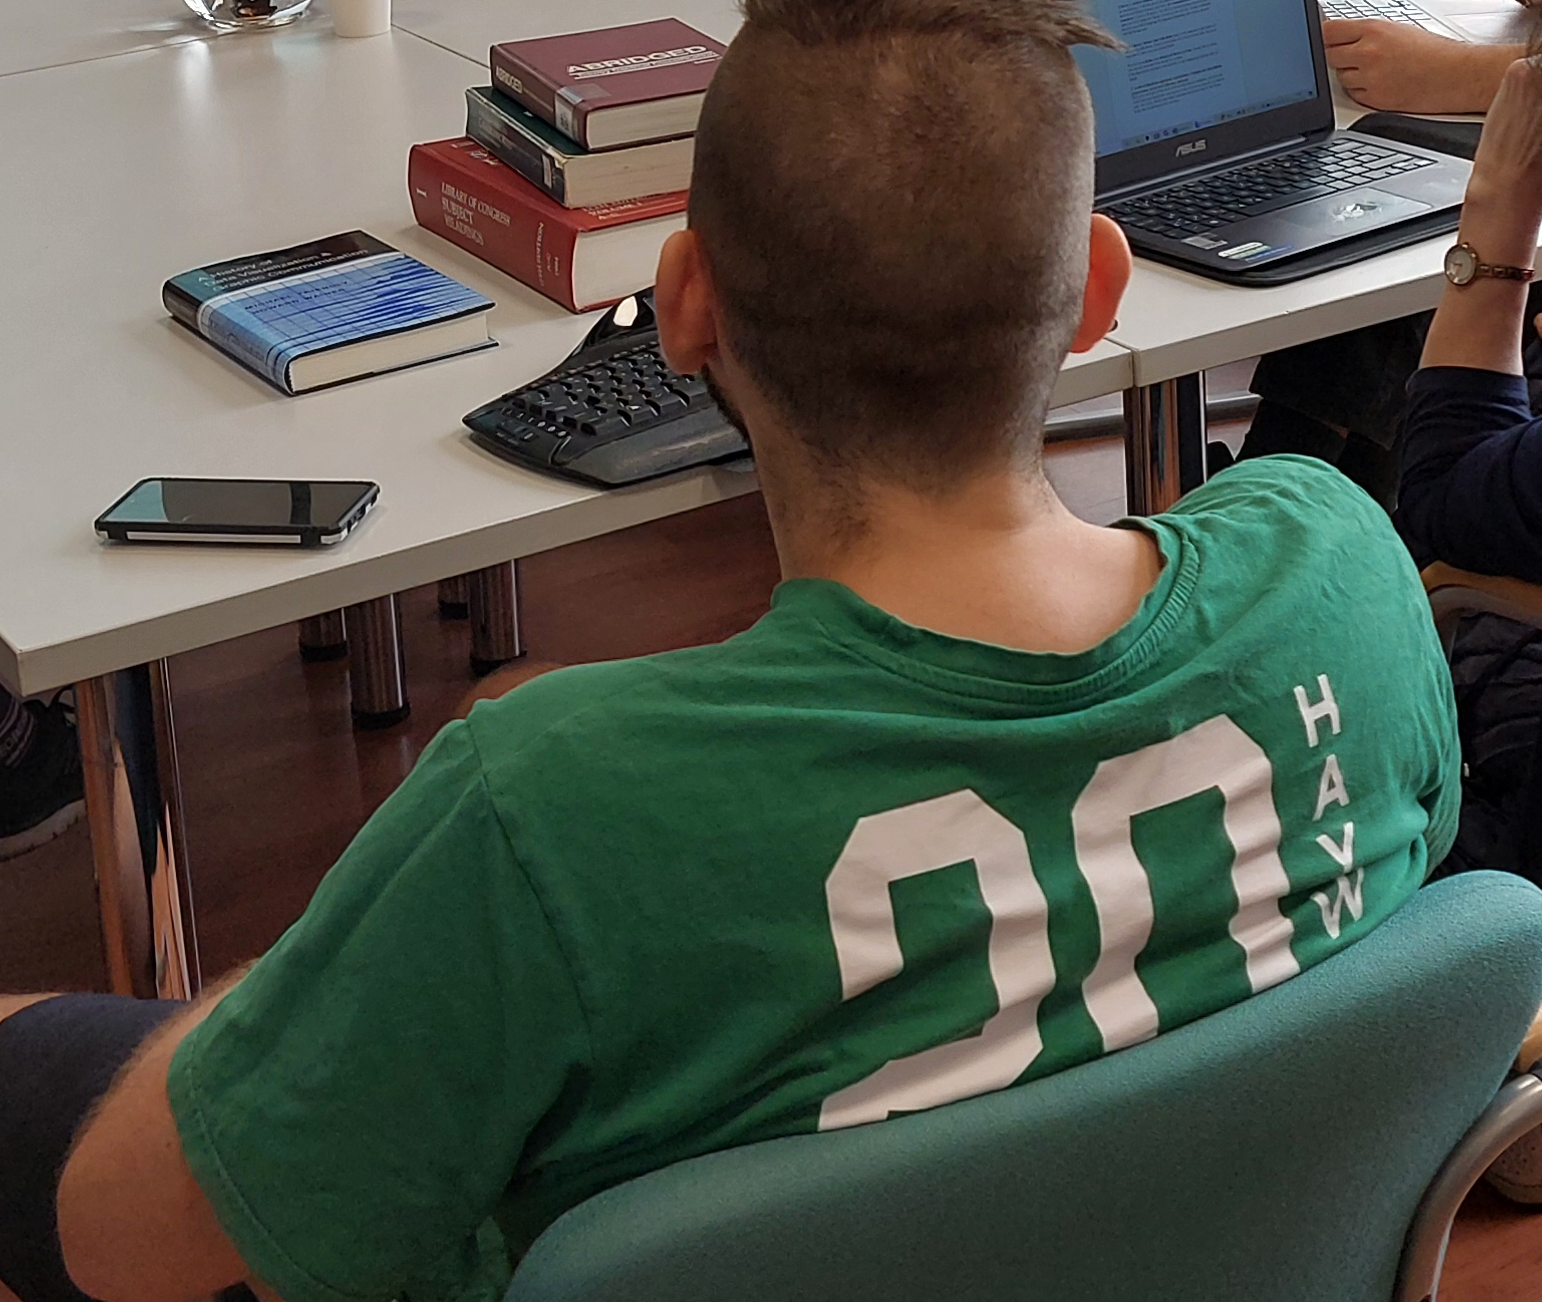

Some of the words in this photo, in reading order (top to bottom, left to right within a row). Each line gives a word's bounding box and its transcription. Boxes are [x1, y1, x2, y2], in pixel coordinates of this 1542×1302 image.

[566, 45, 707, 74] ABRIDGED
[1174, 139, 1207, 158] ASUS
[441, 181, 469, 204] LIBRARY
[477, 197, 511, 228] CONGRESS
[441, 196, 475, 225] SUBJECT
[207, 262, 257, 280] History
[211, 275, 267, 294] Graphic
[267, 248, 370, 277] Communication
[238, 255, 317, 278] Visualization
